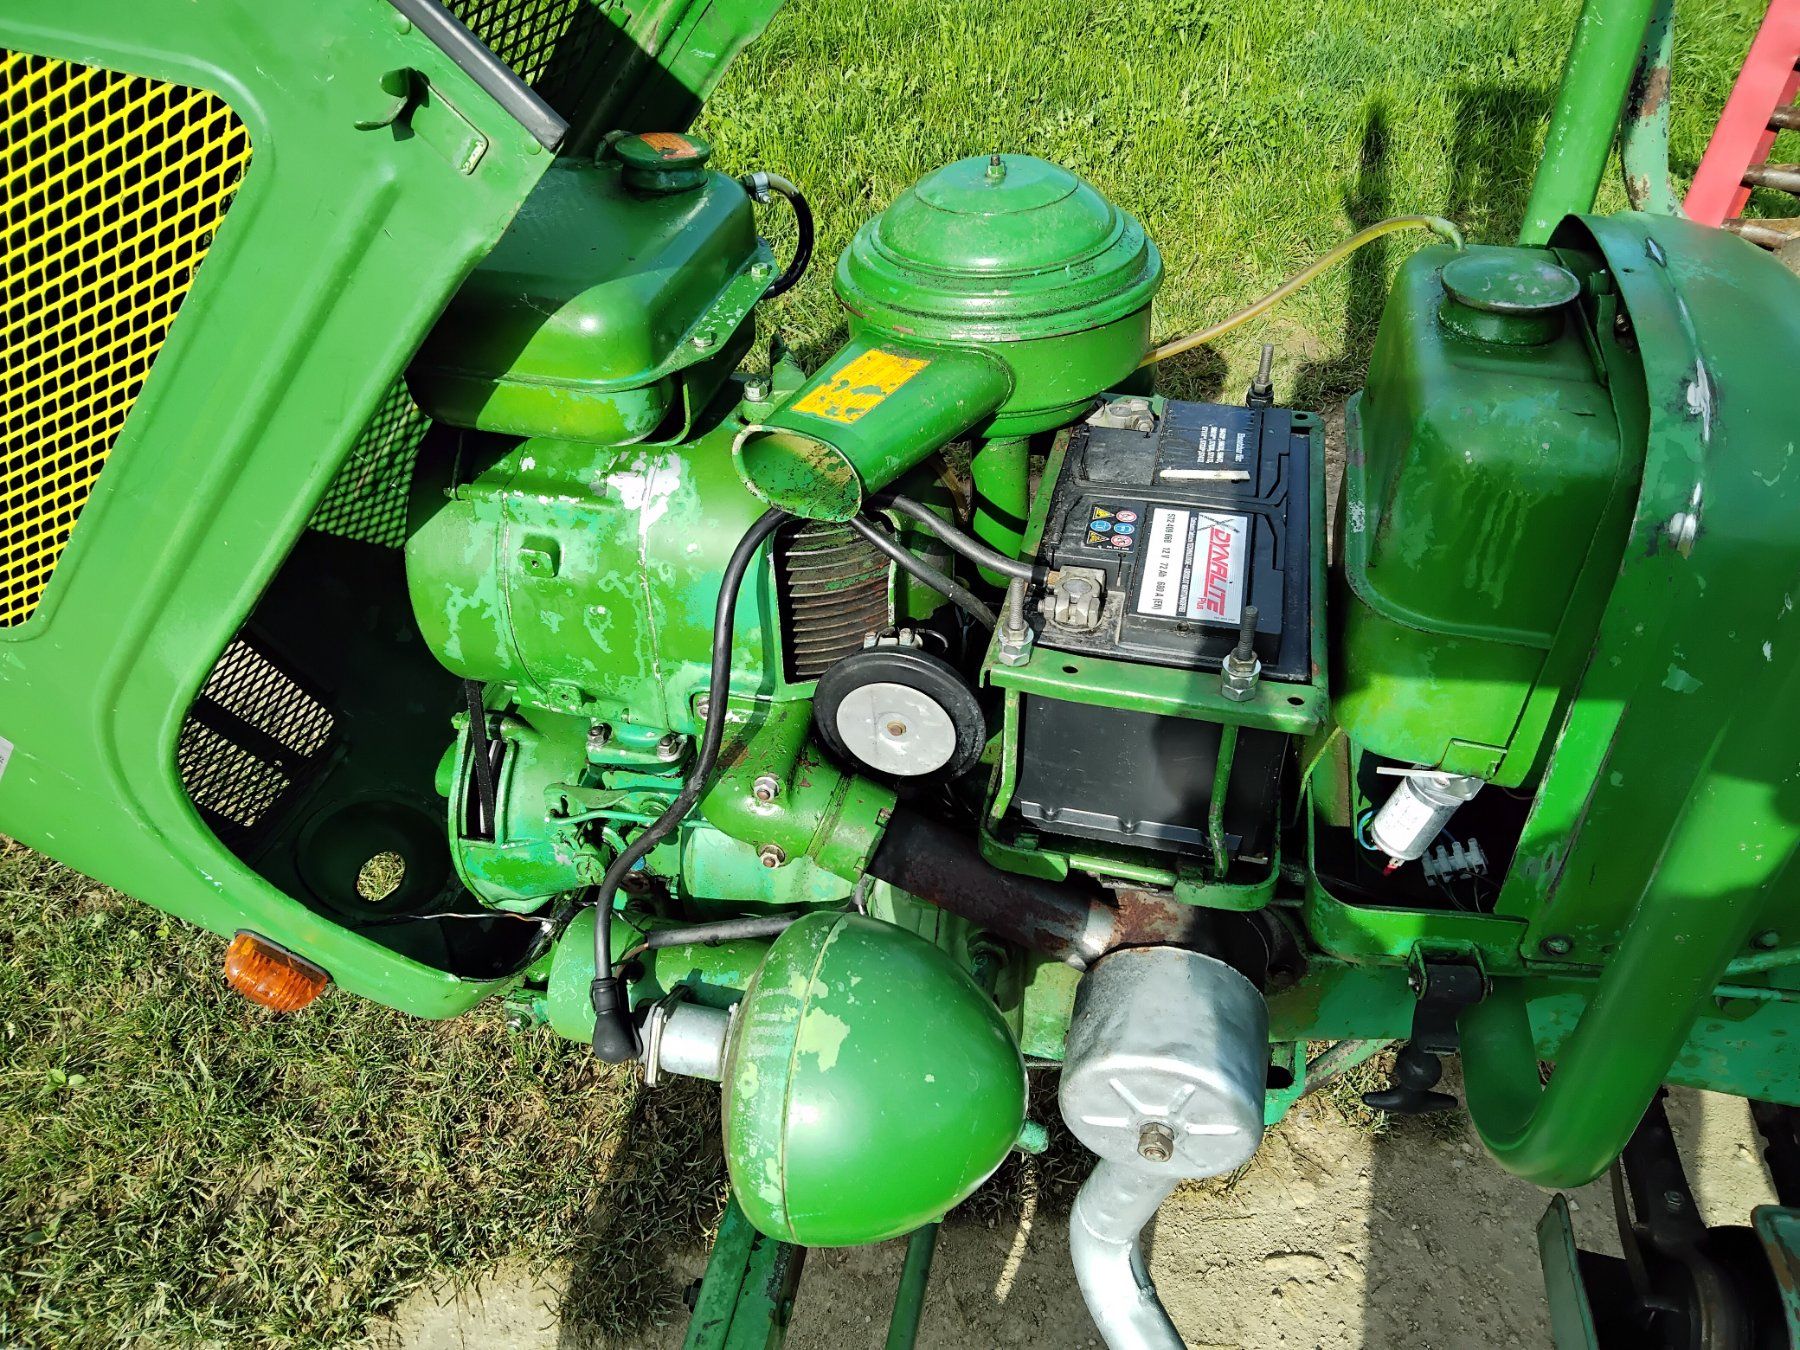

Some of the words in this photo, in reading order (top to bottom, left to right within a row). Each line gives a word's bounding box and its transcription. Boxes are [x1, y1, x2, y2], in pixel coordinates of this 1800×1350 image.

[1167, 513, 1176, 523] 572
[1160, 562, 1169, 570] 72
[1158, 570, 1167, 578] Ah
[1206, 527, 1231, 616] DYNALITE
[1156, 581, 1166, 592] 680
[1196, 597, 1207, 610] Plus
